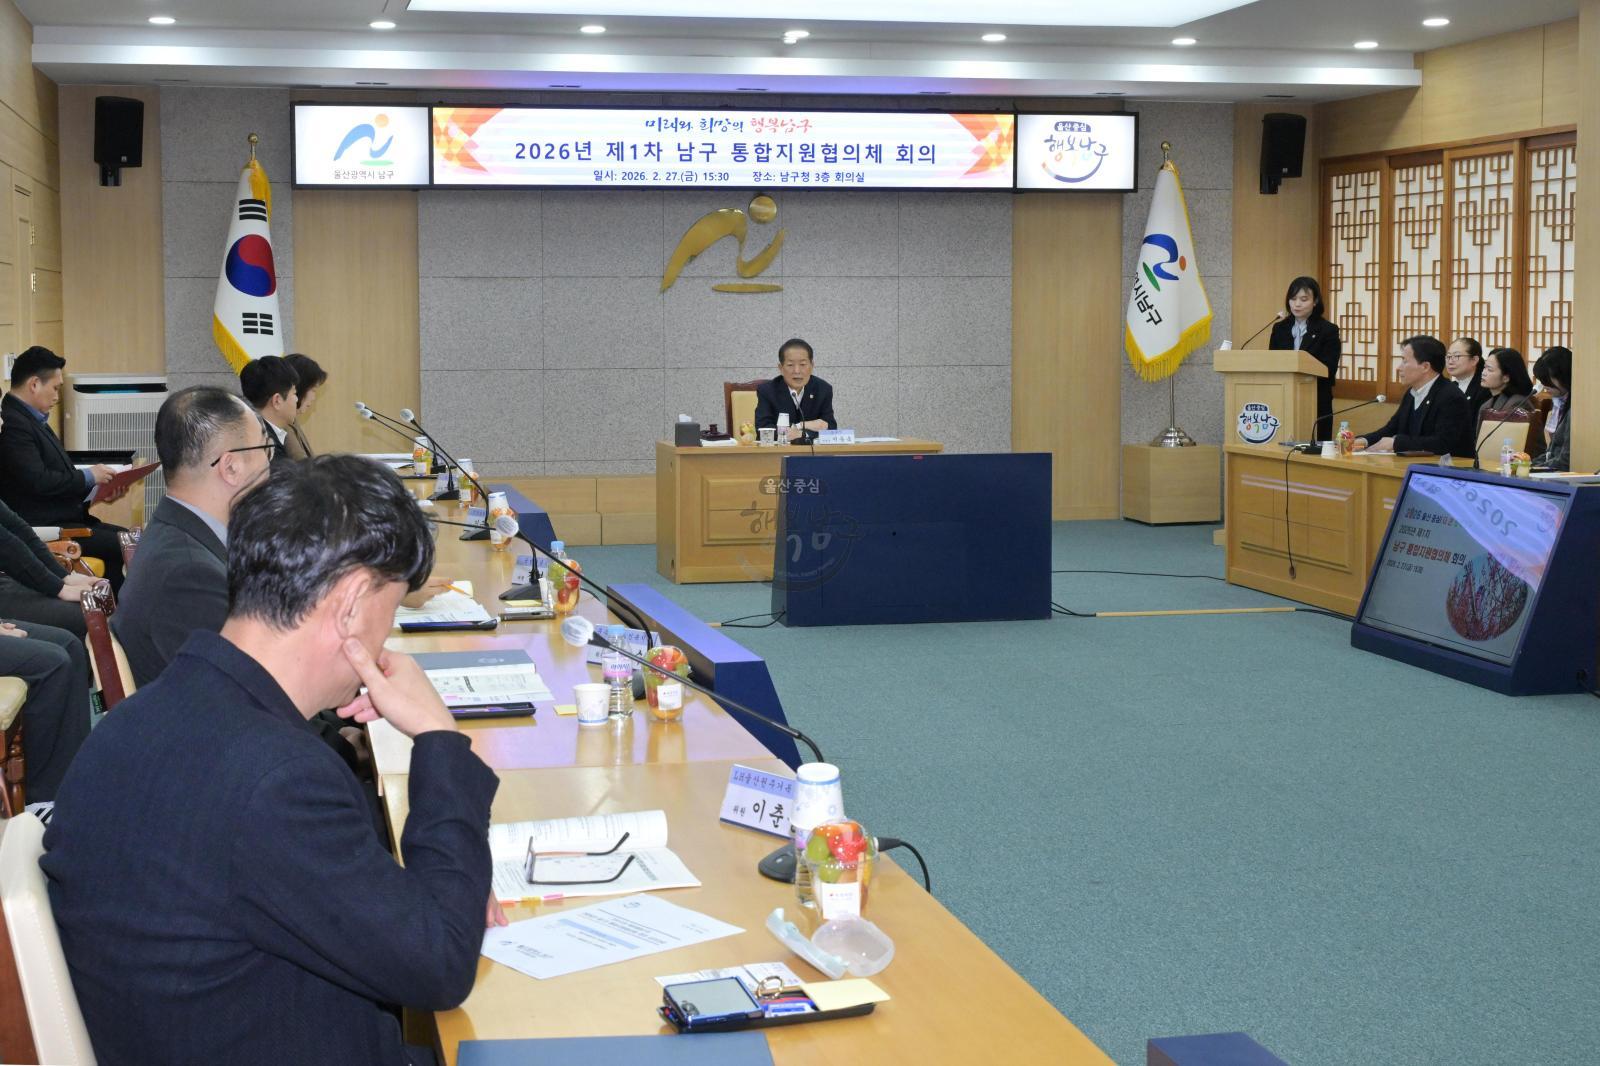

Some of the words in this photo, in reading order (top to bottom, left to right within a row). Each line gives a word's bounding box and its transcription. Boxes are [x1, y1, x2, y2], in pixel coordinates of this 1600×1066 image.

[700, 117, 744, 133] 희망의
[751, 117, 813, 134] 행복남구
[515, 141, 592, 161] 2026년
[606, 141, 663, 162] 제1차
[677, 142, 717, 163] 남구
[731, 142, 882, 164] 통합지원협의체
[895, 144, 936, 164] 회의
[334, 169, 375, 180] 울산광역시
[378, 169, 395, 180] 남구
[593, 170, 617, 182] 일시:
[621, 171, 648, 181] 2026.
[652, 171, 661, 181] 2.
[703, 171, 729, 182] 15:30
[752, 171, 776, 183] 장소:
[780, 171, 810, 183] 남구청
[814, 171, 831, 183] 3층
[834, 171, 865, 183] 회의실
